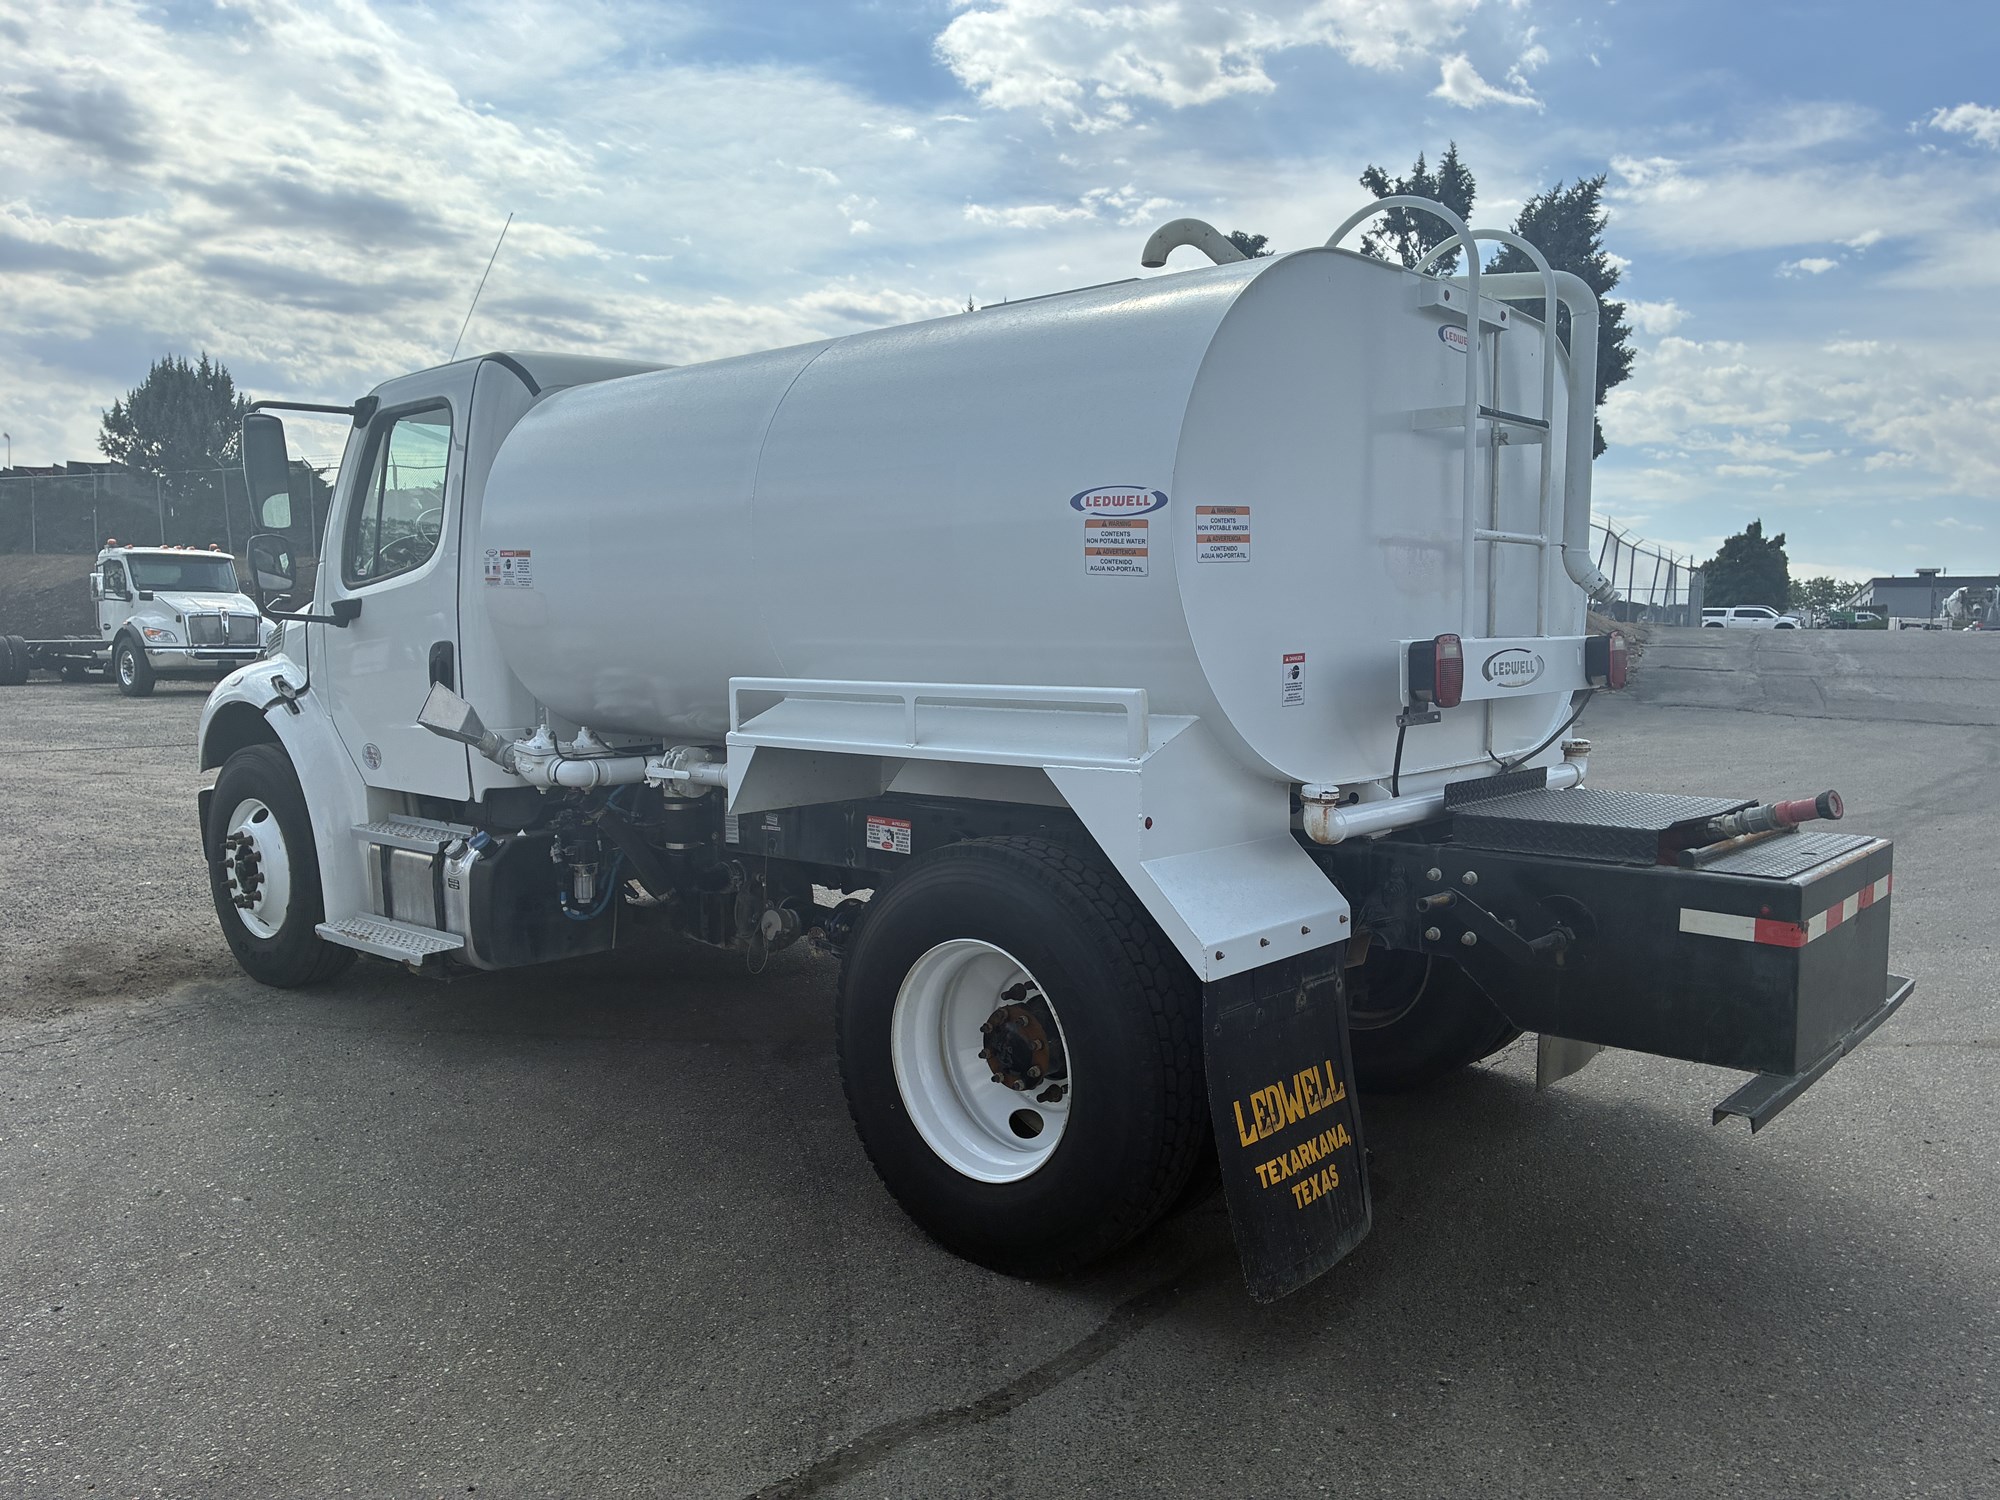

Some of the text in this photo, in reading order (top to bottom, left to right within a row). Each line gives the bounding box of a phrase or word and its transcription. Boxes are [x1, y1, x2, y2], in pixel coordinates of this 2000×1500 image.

[1445, 330, 1468, 346] LEDWE
[1085, 495, 1151, 507] LEDWELL
[1100, 530, 1131, 538] CONTENTS
[1100, 558, 1133, 566] CONTENIDO
[1493, 660, 1535, 676] LEDWELL
[1233, 1059, 1346, 1148] LEDWELL
[1255, 1123, 1352, 1189] TEXARKANA,
[1291, 1163, 1339, 1210] TEXAS
